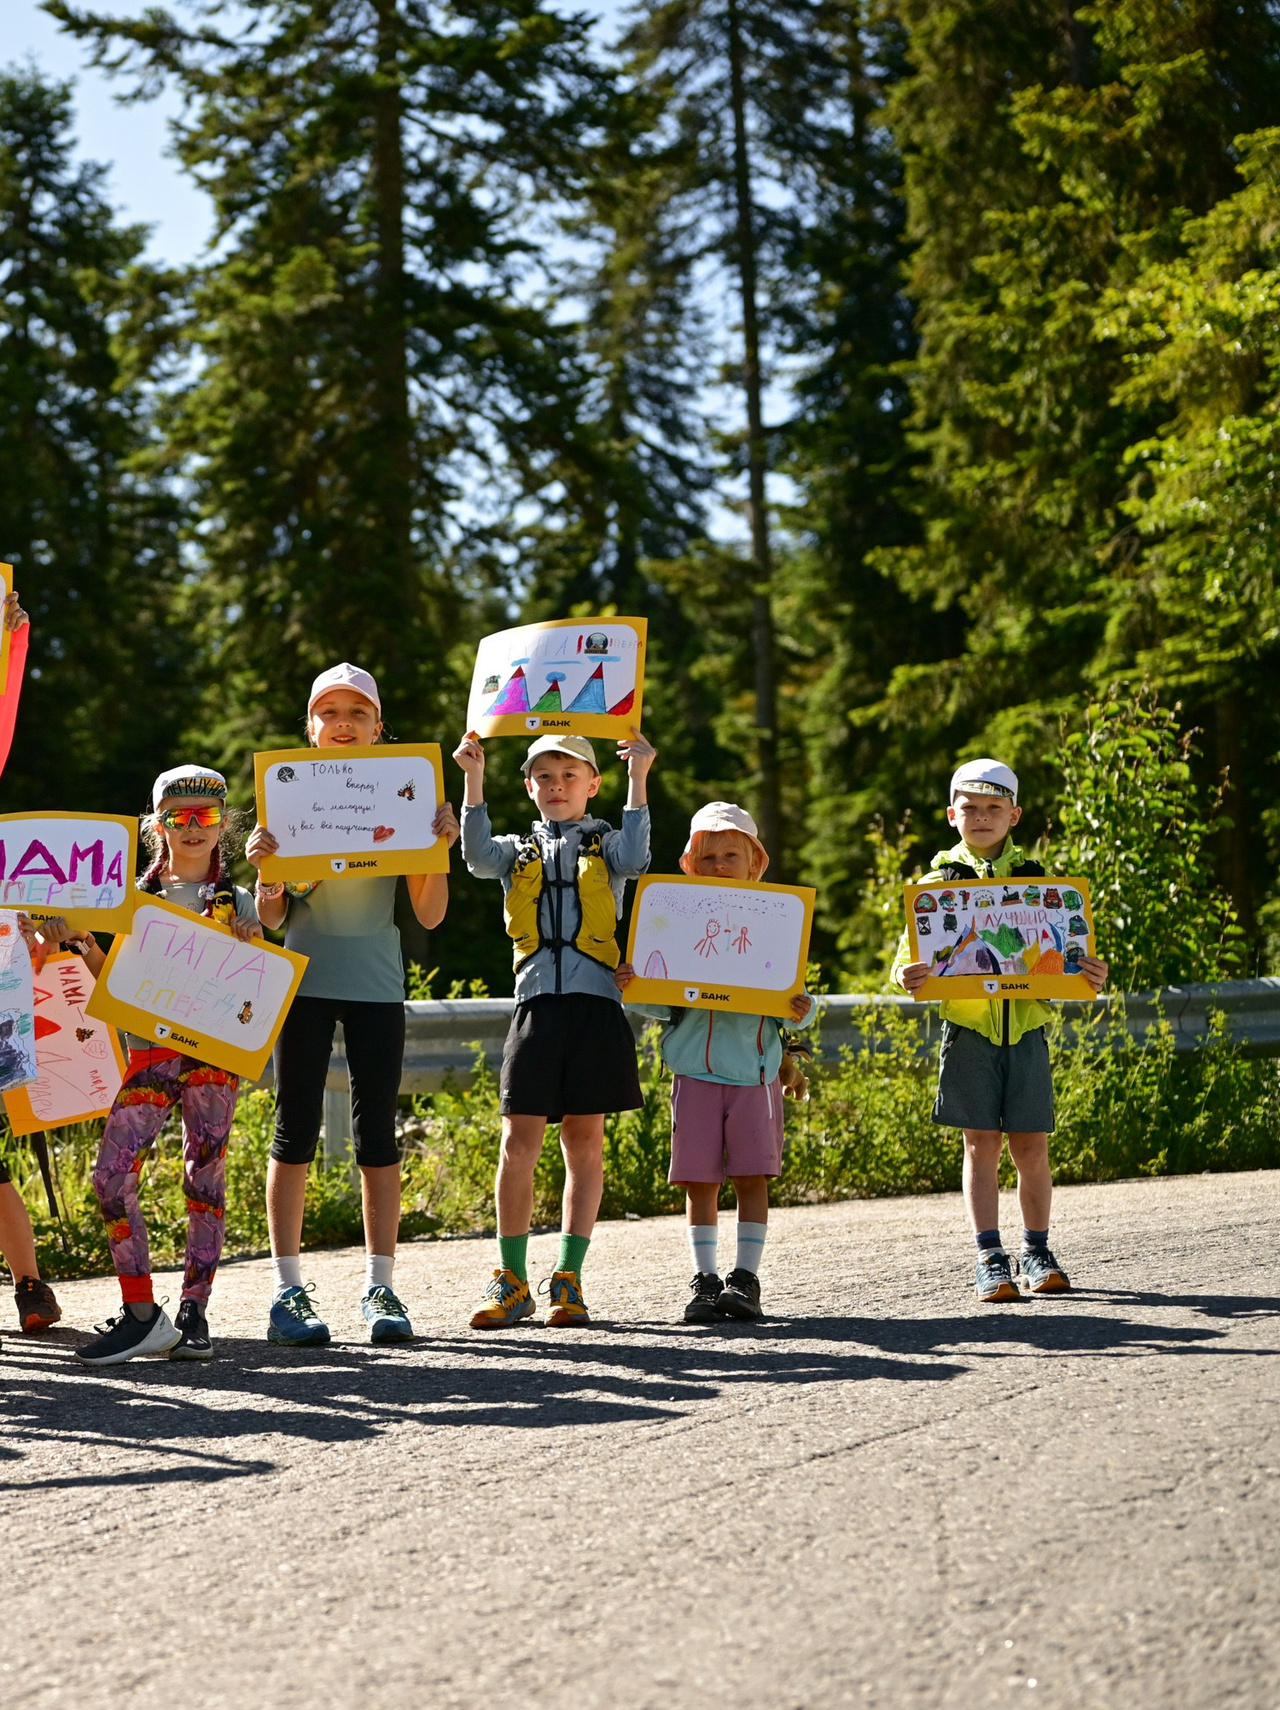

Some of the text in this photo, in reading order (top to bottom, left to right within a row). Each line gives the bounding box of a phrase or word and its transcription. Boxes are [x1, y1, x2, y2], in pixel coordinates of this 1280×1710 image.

[542, 719, 571, 727] БАНК
[348, 860, 378, 869] БАНК
[30, 913, 63, 922] БАН
[138, 919, 268, 999] ПАПА
[57, 965, 87, 1007] МАМА
[700, 992, 730, 1002] БАНК
[170, 1031, 200, 1049] БАНК
